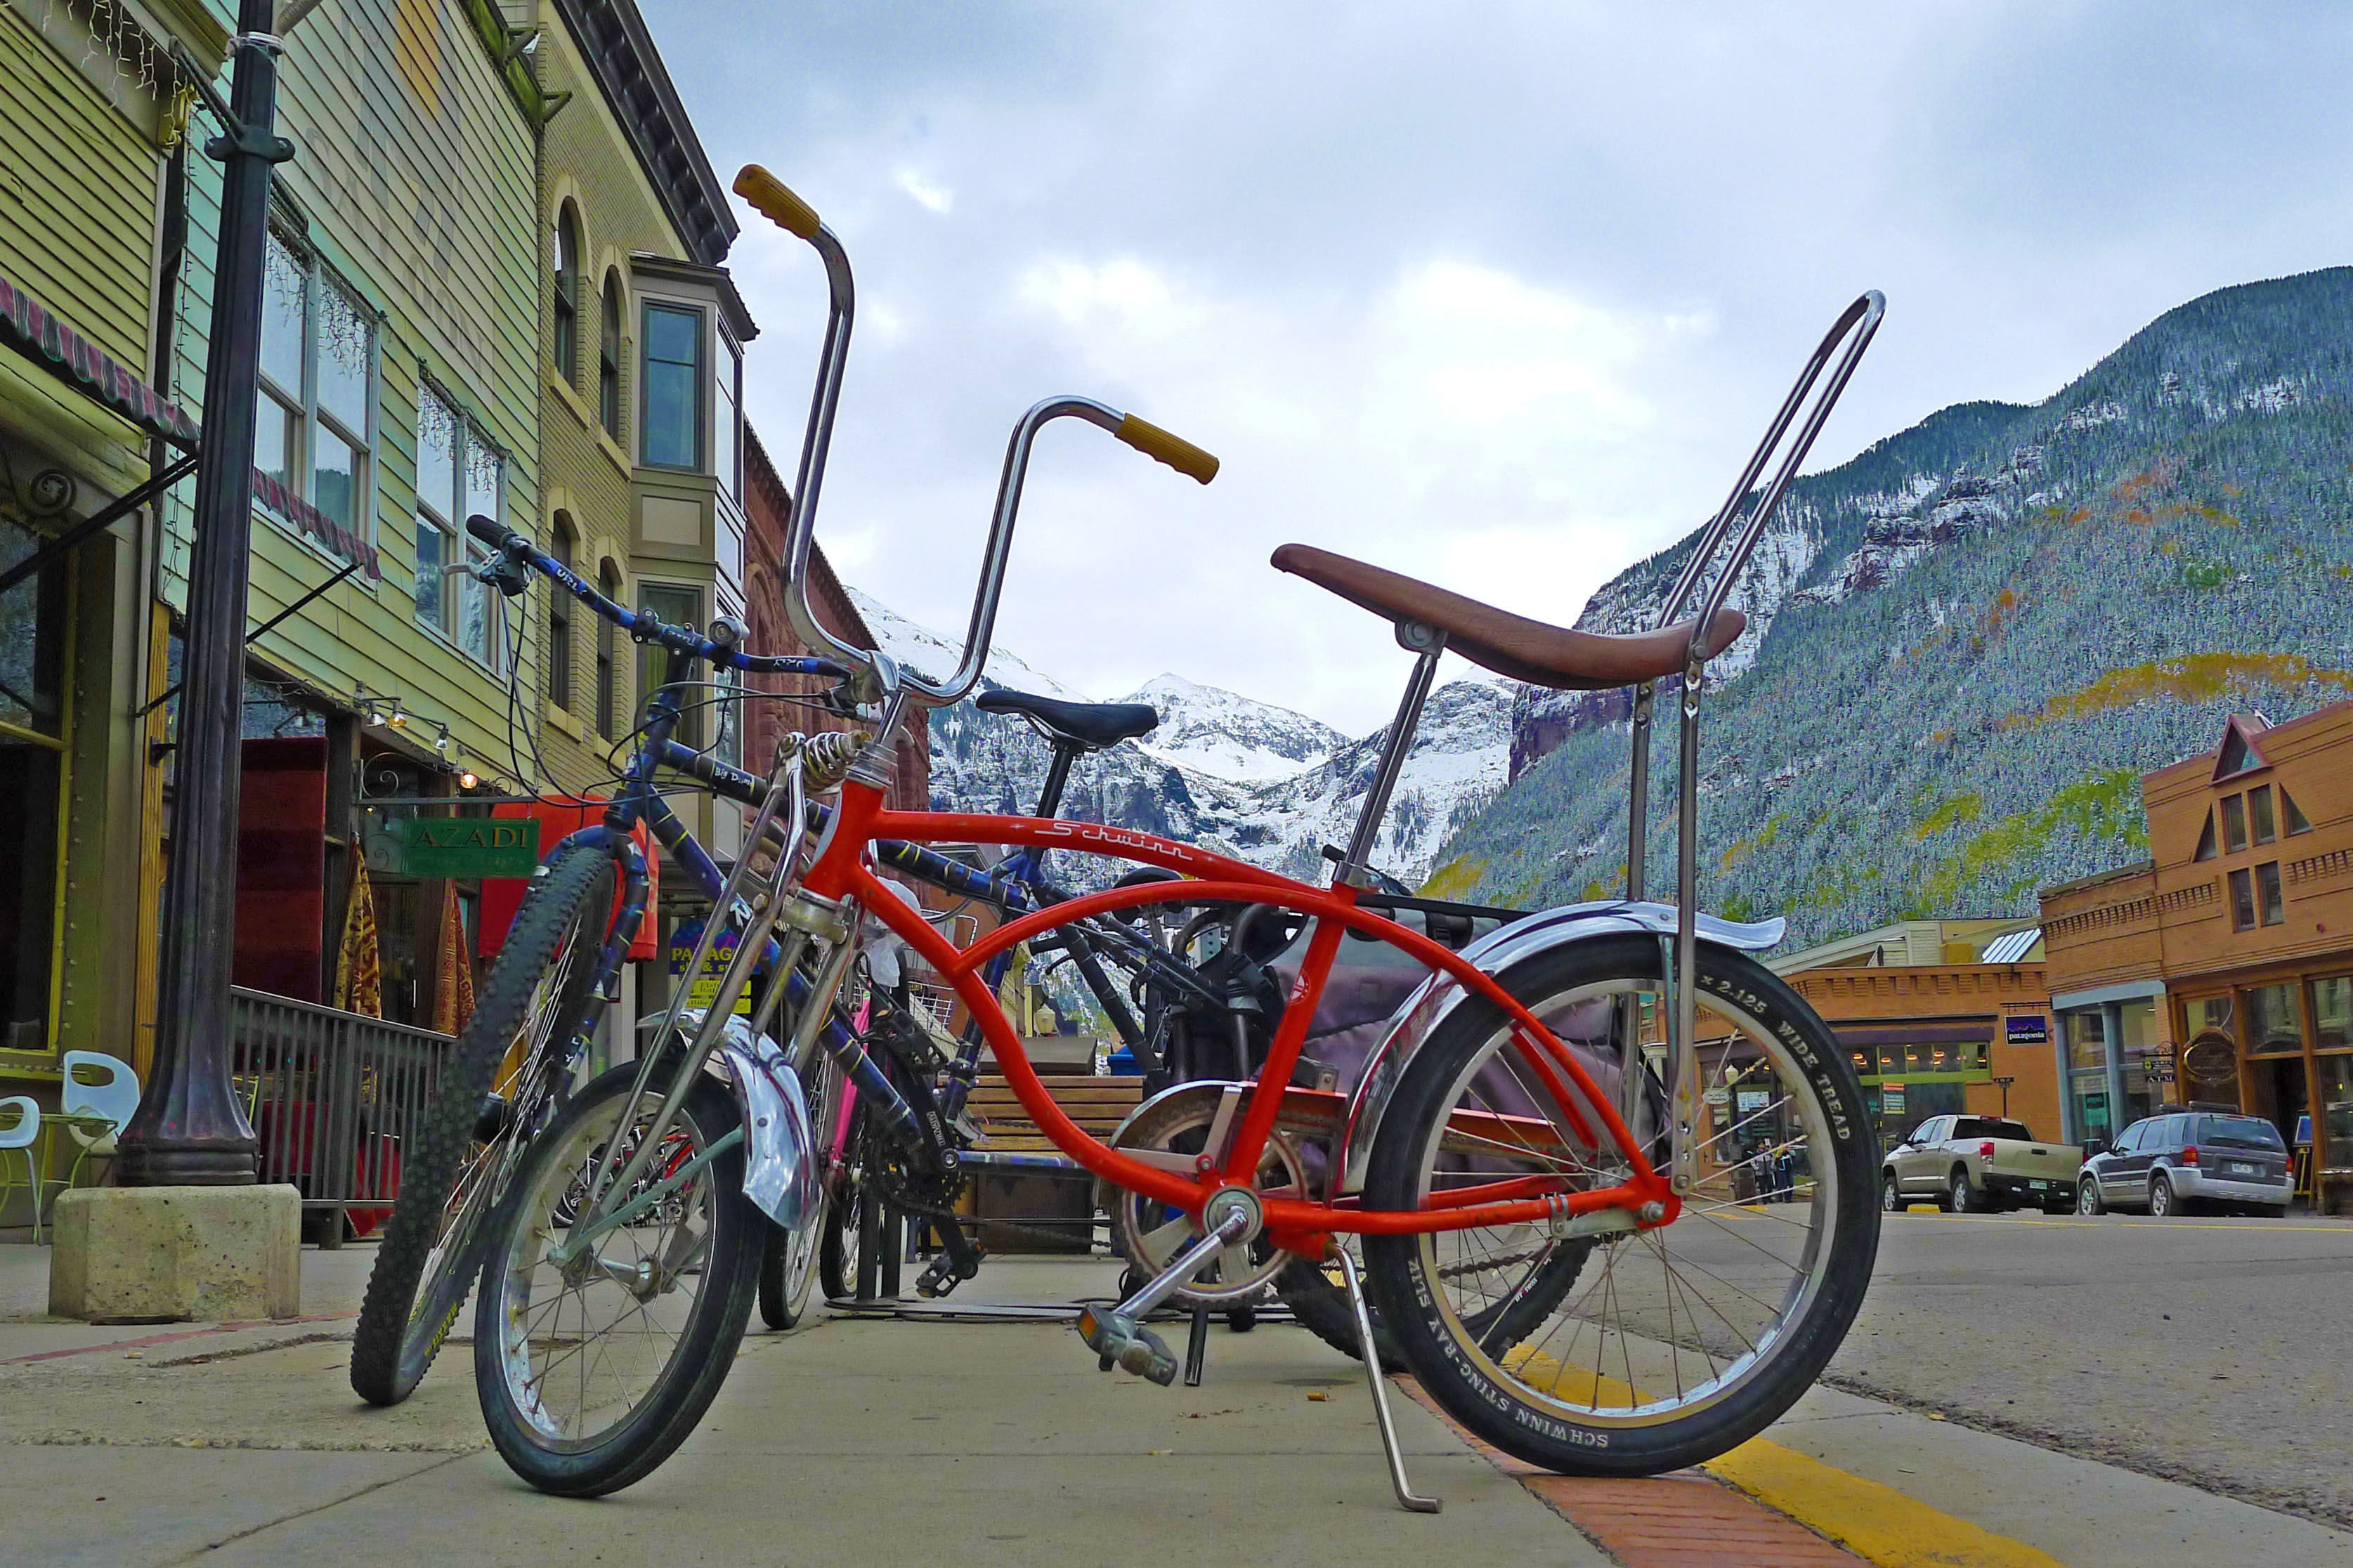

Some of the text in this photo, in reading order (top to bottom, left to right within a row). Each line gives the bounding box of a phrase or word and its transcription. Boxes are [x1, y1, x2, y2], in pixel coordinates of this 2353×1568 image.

[410, 827, 528, 849] AZADI
[1034, 823, 1193, 861] Schwinn
[2009, 1032, 2045, 1040] patagonia
[1716, 981, 1768, 1013] 2.125
[1778, 1021, 1819, 1068] WIDE
[1817, 1073, 1850, 1139] TREAD
[1408, 1257, 1608, 1448] SCHWINN STING-RAY SLIK
